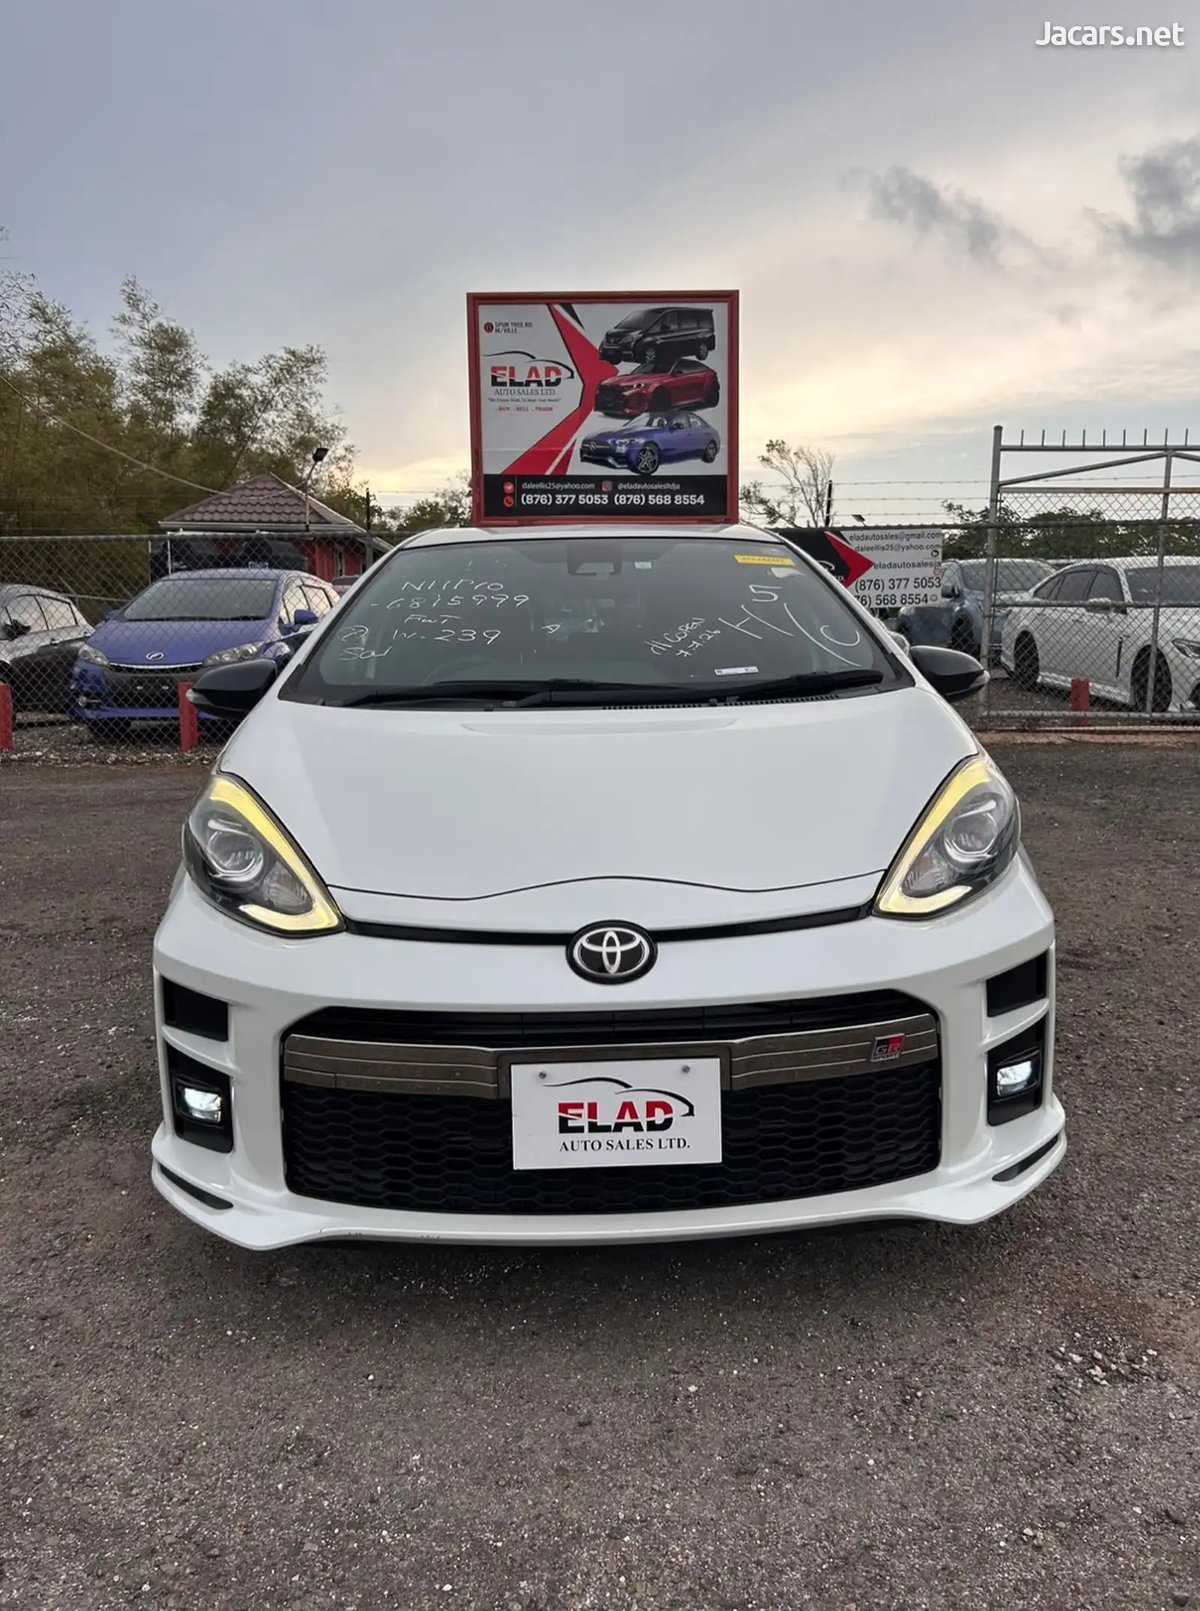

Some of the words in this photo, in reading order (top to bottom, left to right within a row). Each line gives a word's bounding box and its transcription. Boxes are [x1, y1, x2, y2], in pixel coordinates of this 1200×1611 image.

[491, 366, 562, 387] ELAD
[494, 388, 516, 396] AUTO
[516, 388, 540, 396] SALES
[521, 494, 553, 505] (876)
[555, 494, 577, 505] 377
[578, 494, 609, 505] 5053
[614, 494, 645, 505] (876)
[648, 494, 672, 505] 568
[674, 494, 705, 505] 8554
[849, 531, 941, 542] eladautosales@gmail.com
[855, 579, 885, 593] (876)
[888, 578, 910, 590] 377
[913, 576, 941, 588] 5053
[854, 595, 872, 608] 76)
[875, 594, 897, 606] 568
[900, 593, 928, 605] 8554
[558, 1100, 674, 1134] ELAD
[559, 1139, 602, 1152] AUTO
[605, 1137, 654, 1150] SALES
[658, 1137, 691, 1149] LTD.
